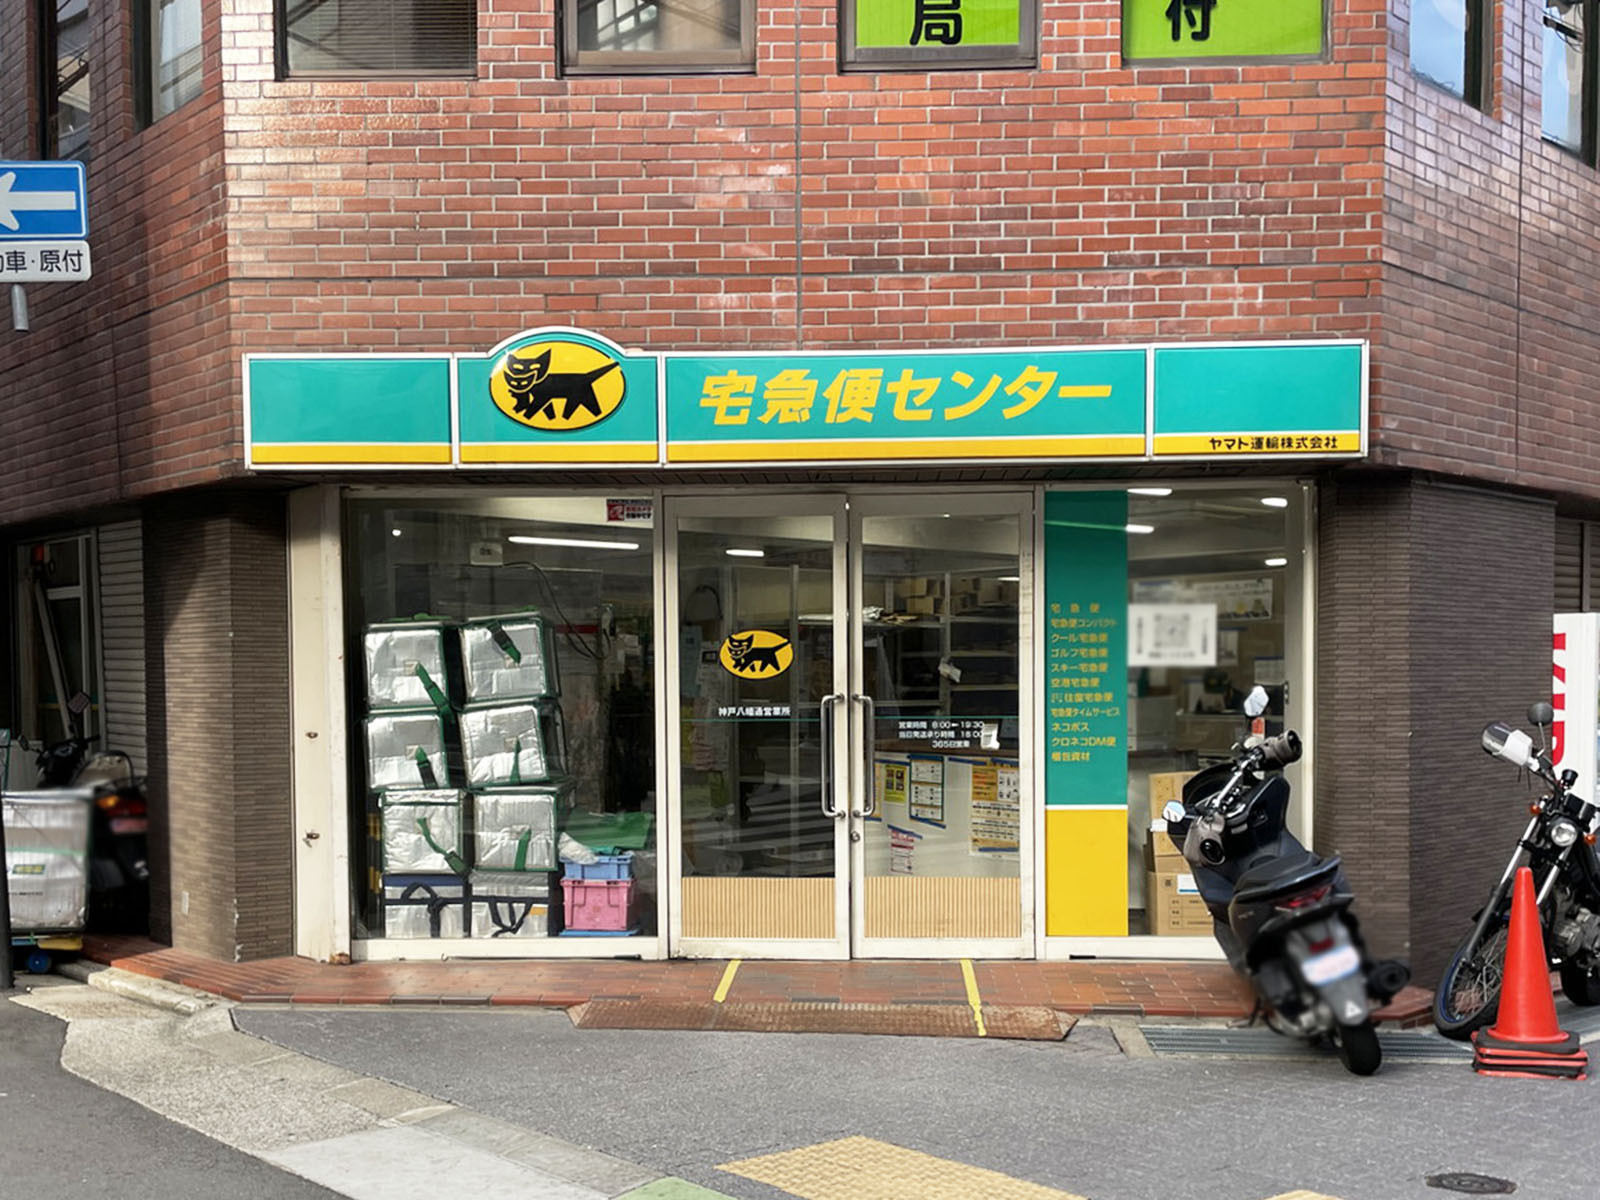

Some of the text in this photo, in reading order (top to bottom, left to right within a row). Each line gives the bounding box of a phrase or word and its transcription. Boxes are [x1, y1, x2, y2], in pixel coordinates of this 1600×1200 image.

[0, 250, 83, 273] 車・原付
[699, 365, 1113, 425] 宅急便センター
[1209, 436, 1337, 450] ヤマト運輸株式会社
